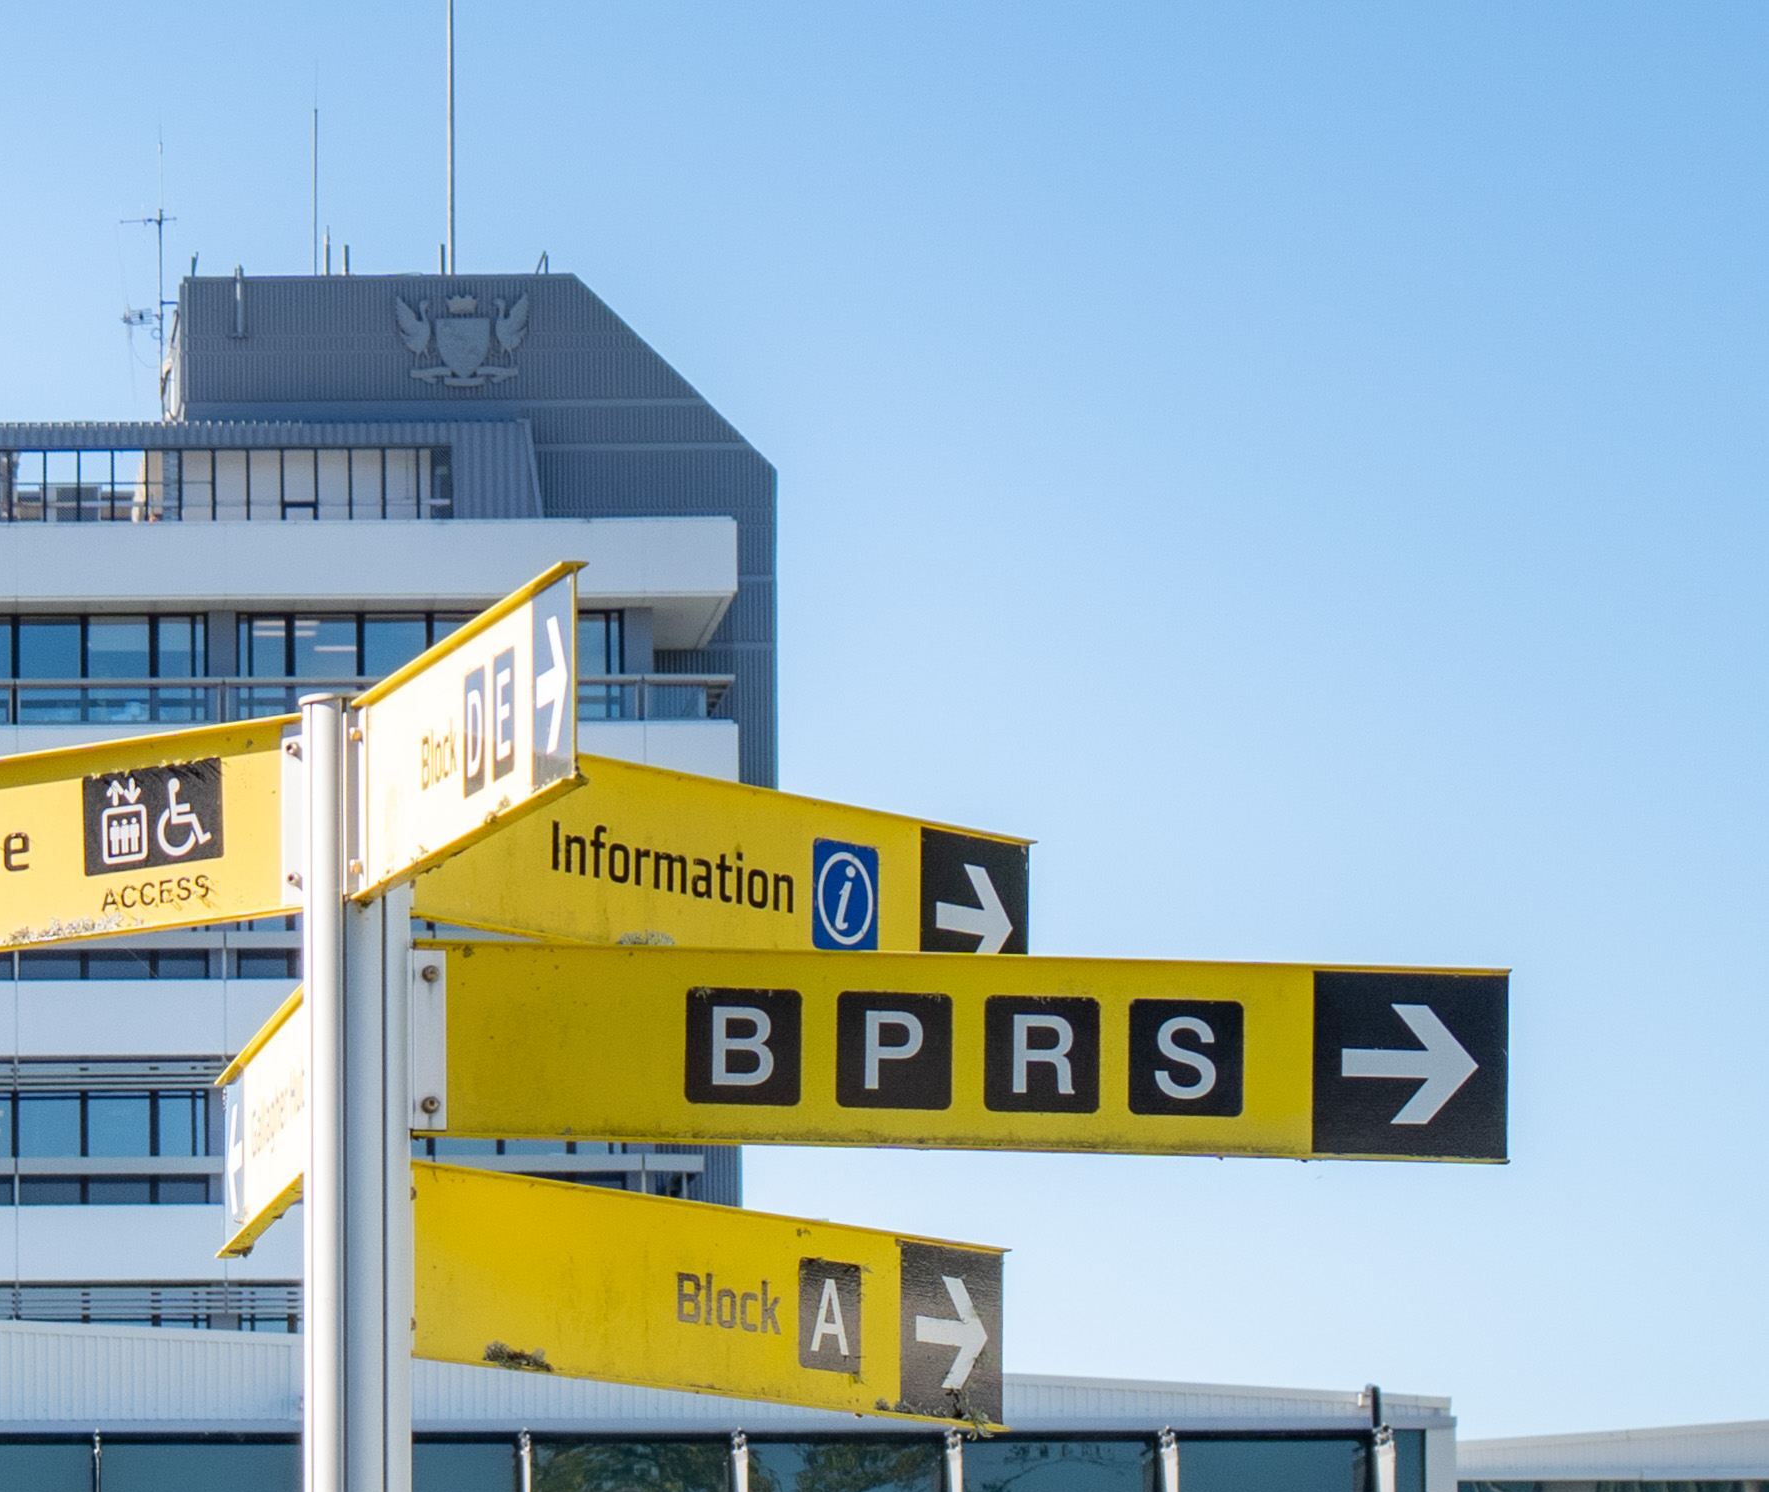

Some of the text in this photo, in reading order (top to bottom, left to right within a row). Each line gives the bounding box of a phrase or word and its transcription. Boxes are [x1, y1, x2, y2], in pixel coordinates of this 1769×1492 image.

[421, 667, 511, 792] Block D E
[101, 874, 210, 912] ACCESS
[552, 820, 794, 914] Information
[711, 1005, 1217, 1100] B P R S
[676, 1271, 850, 1357] Block A
